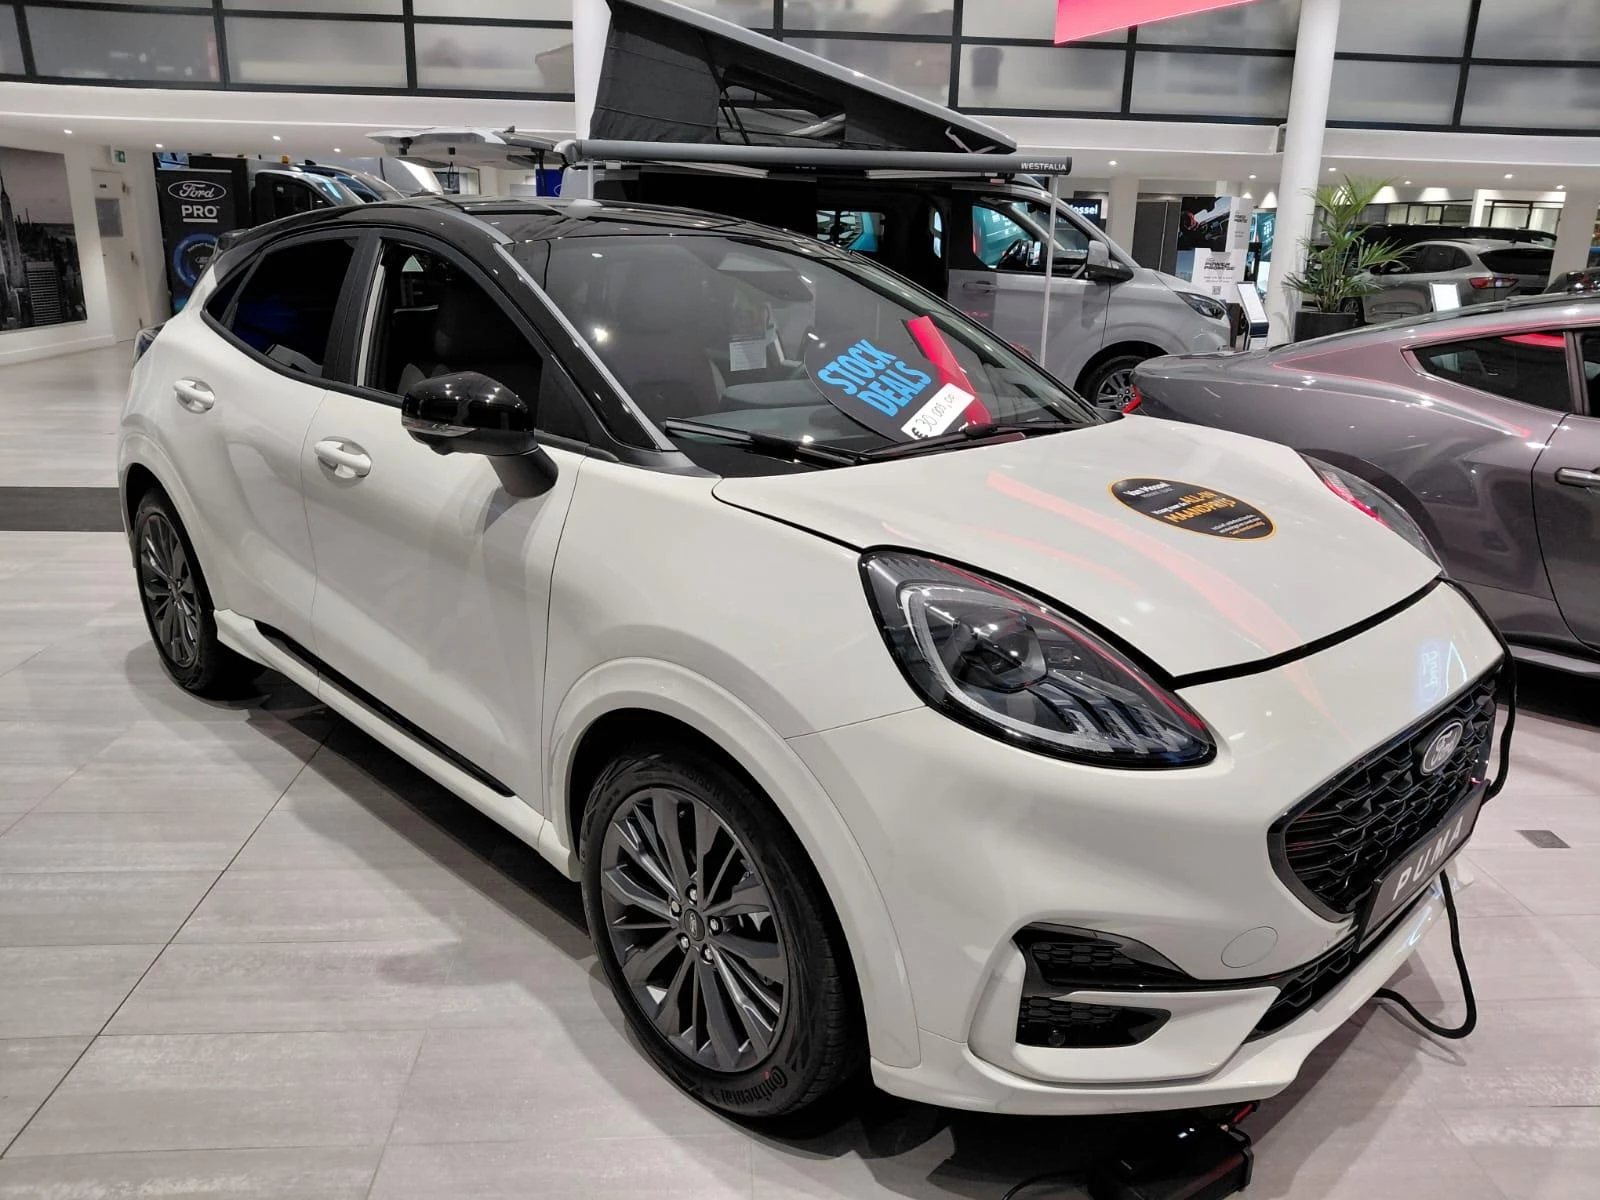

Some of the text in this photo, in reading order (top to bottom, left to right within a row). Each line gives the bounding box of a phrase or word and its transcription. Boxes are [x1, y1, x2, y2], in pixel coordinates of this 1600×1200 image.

[1021, 162, 1067, 171] WESTFALIA
[179, 183, 215, 198] Ford
[181, 205, 217, 217] PRO
[1070, 204, 1098, 215] ossel
[818, 339, 896, 395] STOCK
[857, 361, 931, 417] DEALS
[1391, 815, 1463, 902] PUMA
[721, 1065, 788, 1106] Continental
